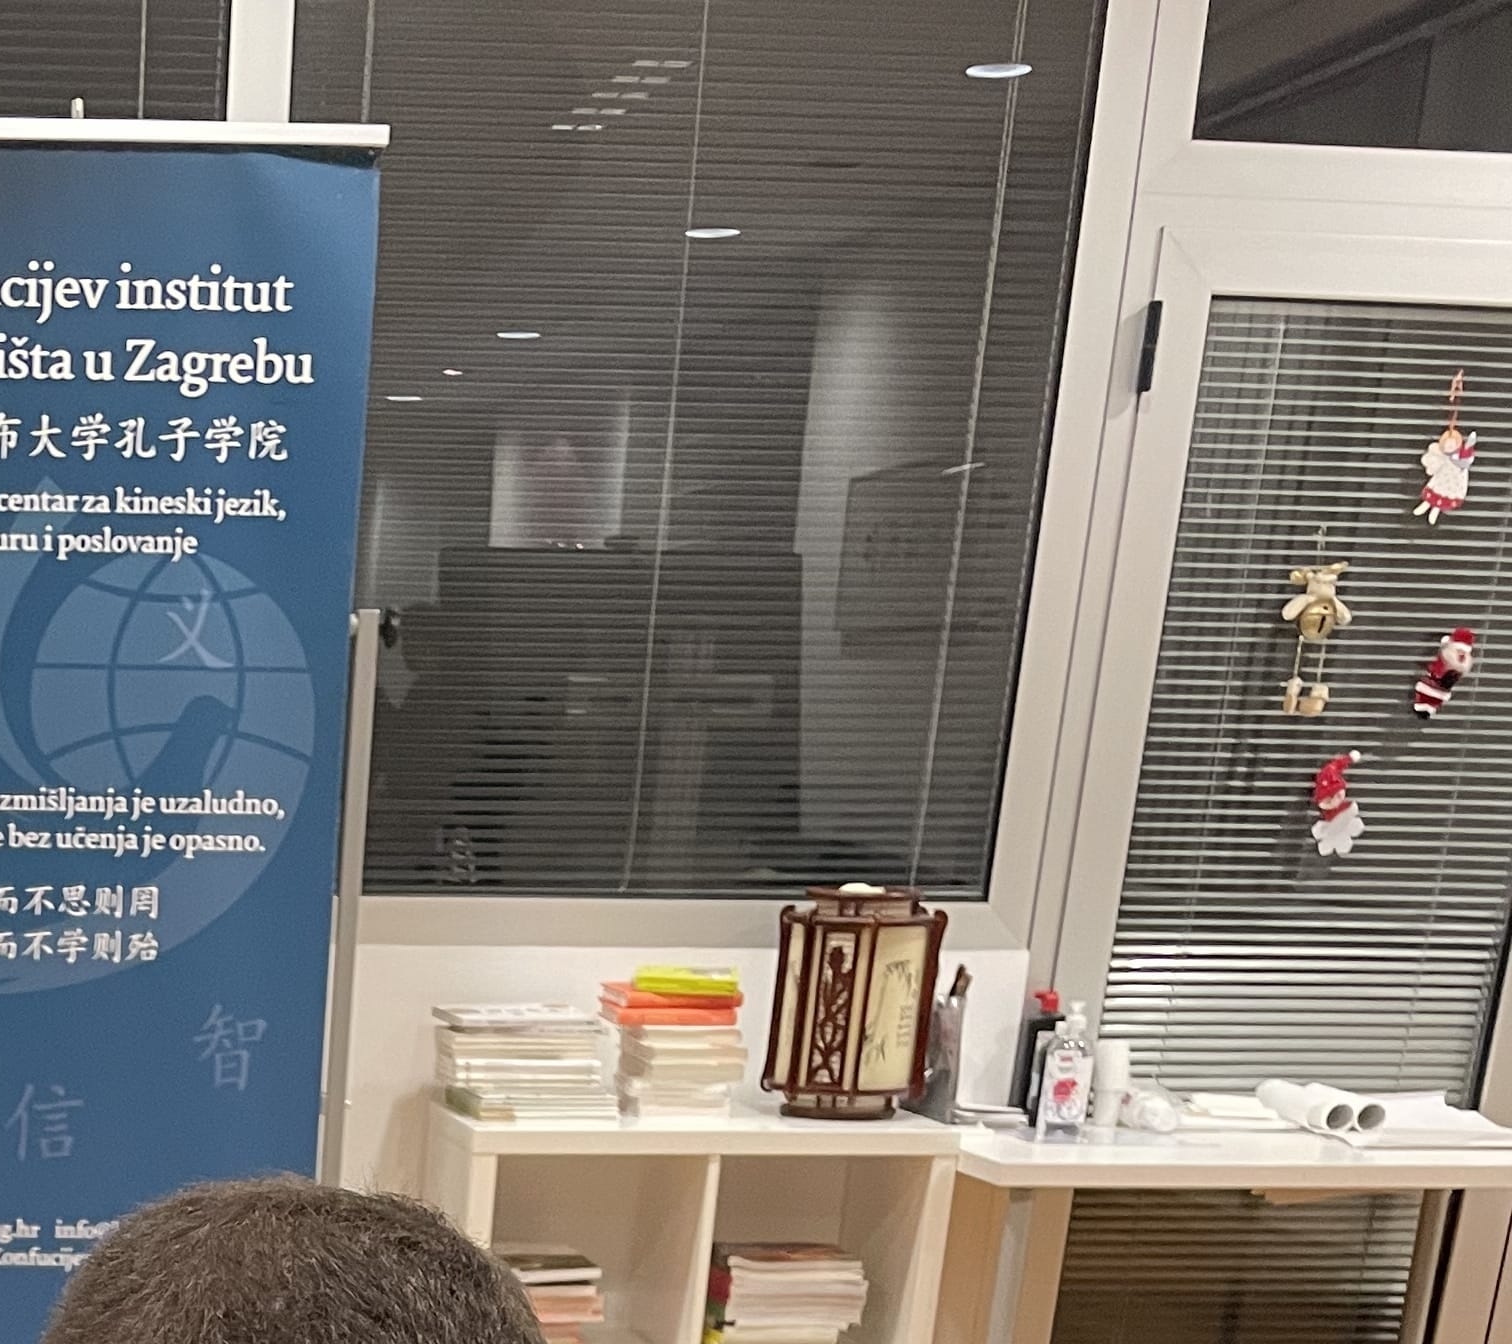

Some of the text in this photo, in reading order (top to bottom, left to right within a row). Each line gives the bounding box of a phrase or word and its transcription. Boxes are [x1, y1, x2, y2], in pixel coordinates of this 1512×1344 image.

[115, 262, 295, 313] institut
[82, 350, 115, 381] u
[123, 336, 315, 398] Zagrebu
[81, 494, 111, 514] za
[115, 486, 213, 515] kineski
[213, 489, 287, 524] jezik,
[42, 525, 54, 552] i
[56, 529, 199, 563] poslovanje
[161, 590, 234, 668] 义
[131, 789, 156, 821] je
[158, 789, 285, 820] uzaludno,
[8, 823, 52, 849] bez
[55, 827, 139, 857] učenja
[140, 825, 167, 858] je
[168, 833, 266, 860] opasno.
[195, 1004, 266, 1090] 智
[5, 1083, 82, 1161] 信
